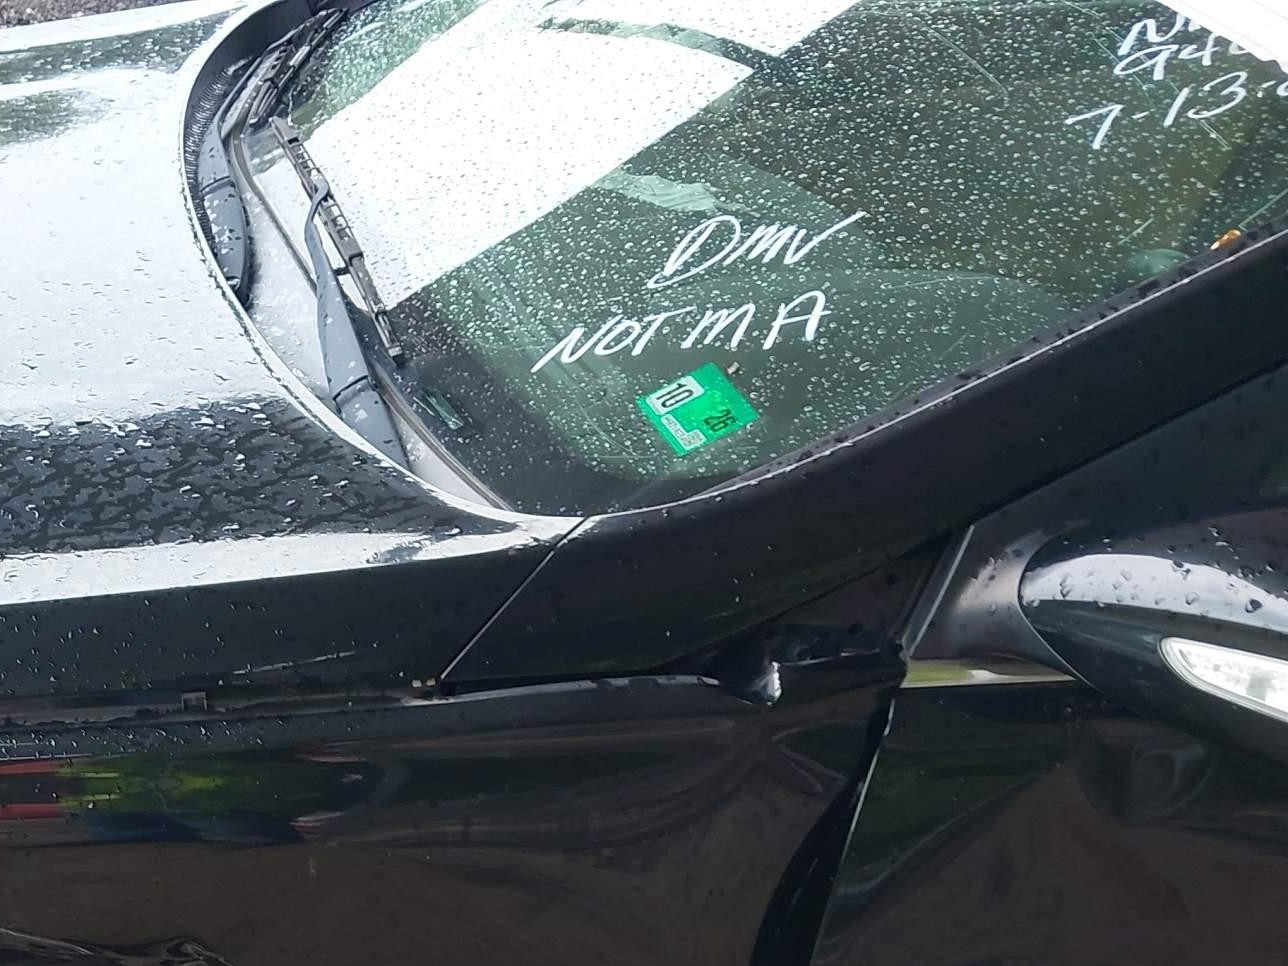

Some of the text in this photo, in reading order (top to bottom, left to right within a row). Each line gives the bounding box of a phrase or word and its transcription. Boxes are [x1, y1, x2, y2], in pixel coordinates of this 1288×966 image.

[647, 211, 867, 289] DMV
[530, 305, 697, 373] NOT
[656, 382, 694, 408] 10
